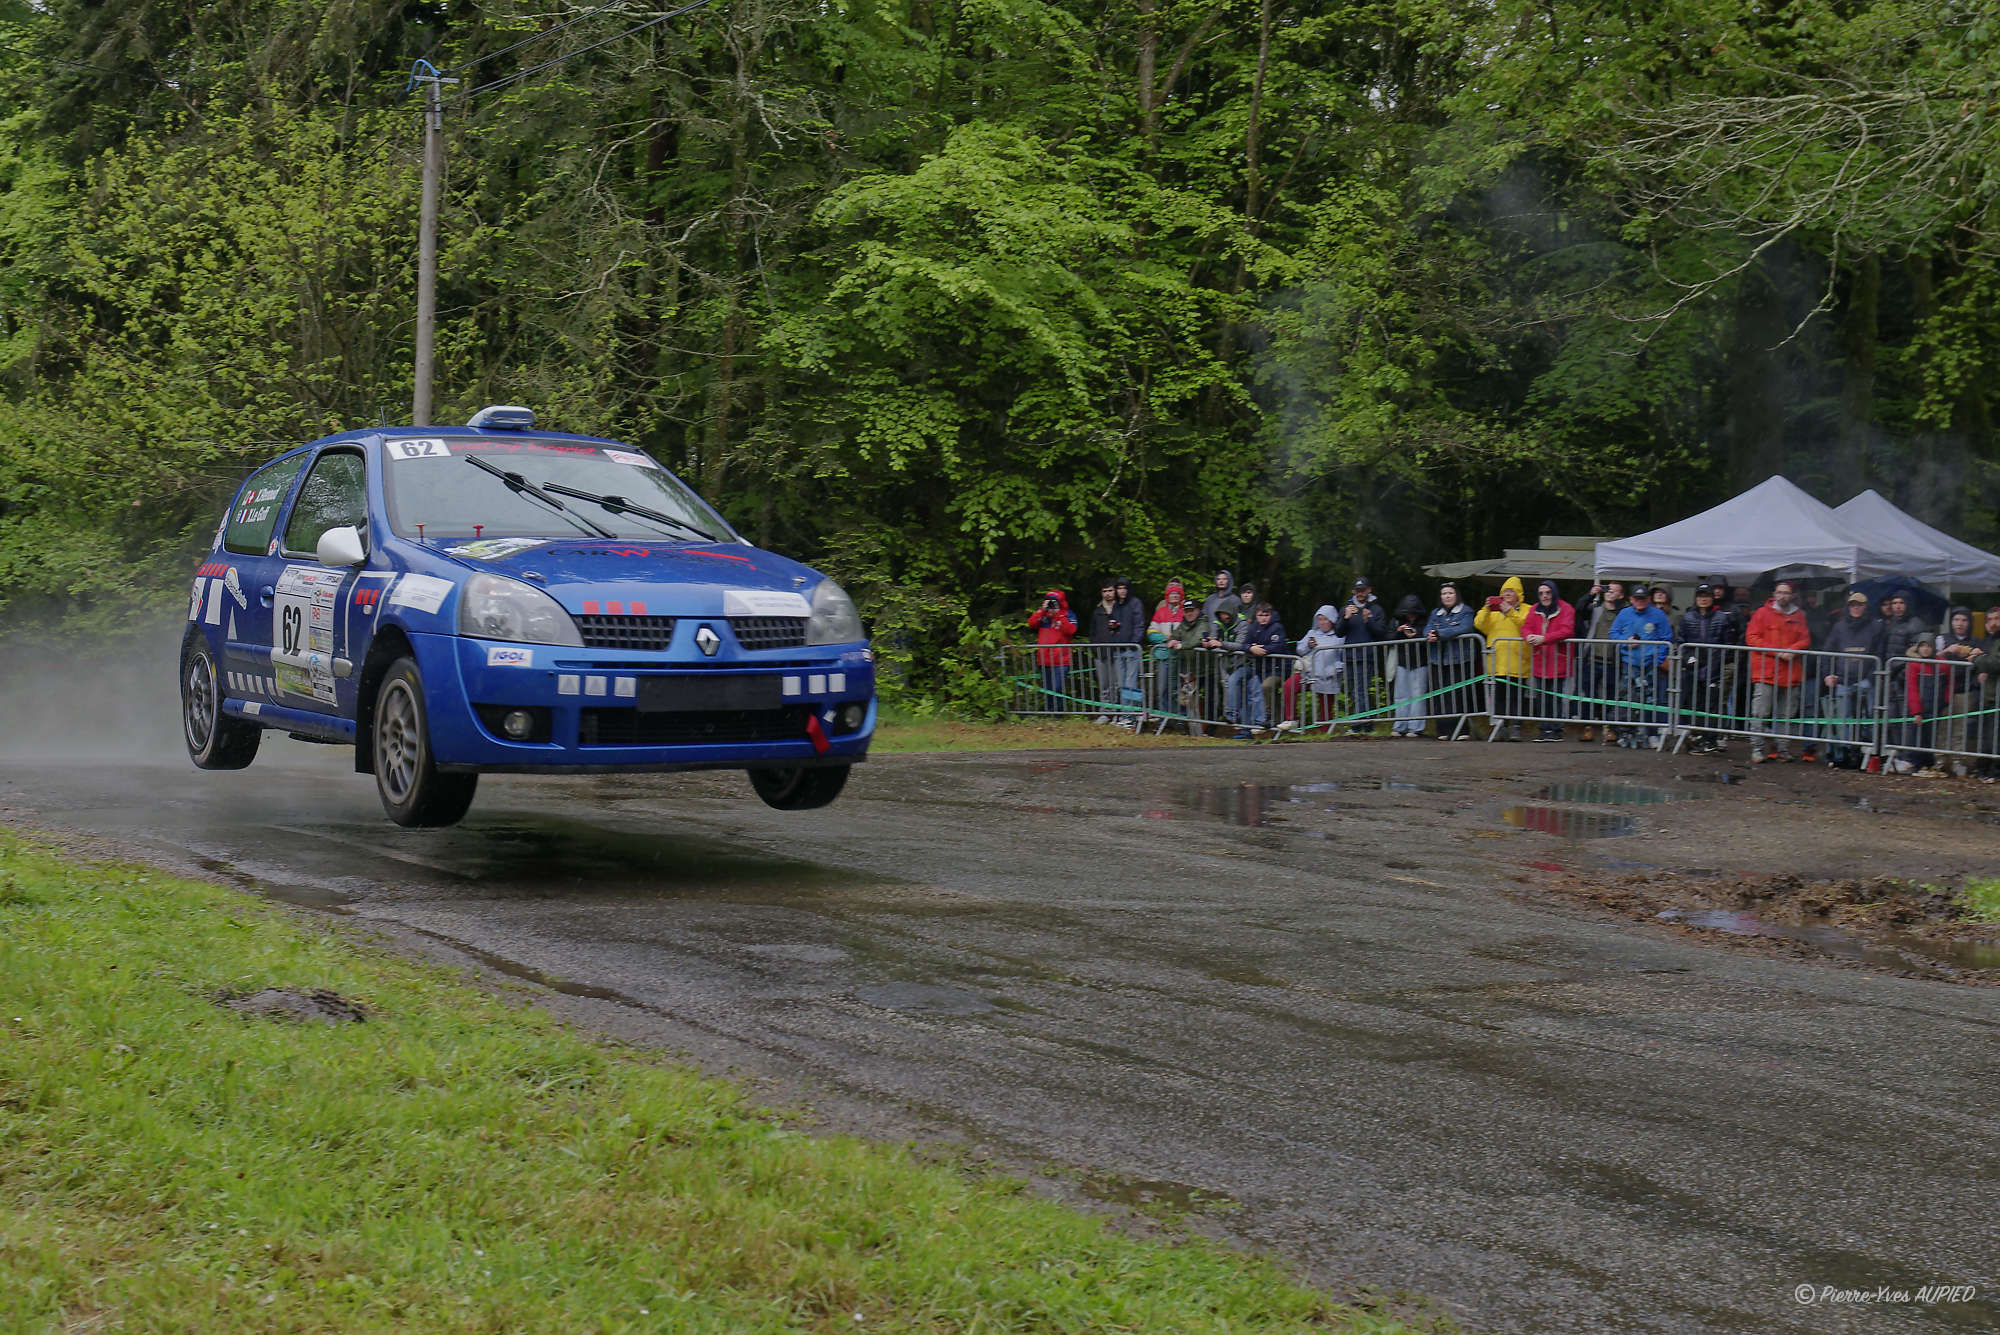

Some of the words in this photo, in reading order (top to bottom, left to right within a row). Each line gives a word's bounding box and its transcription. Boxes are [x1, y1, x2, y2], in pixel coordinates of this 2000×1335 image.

[400, 441, 437, 456] 62
[282, 604, 302, 656] 62
[493, 651, 526, 661] IGOL
